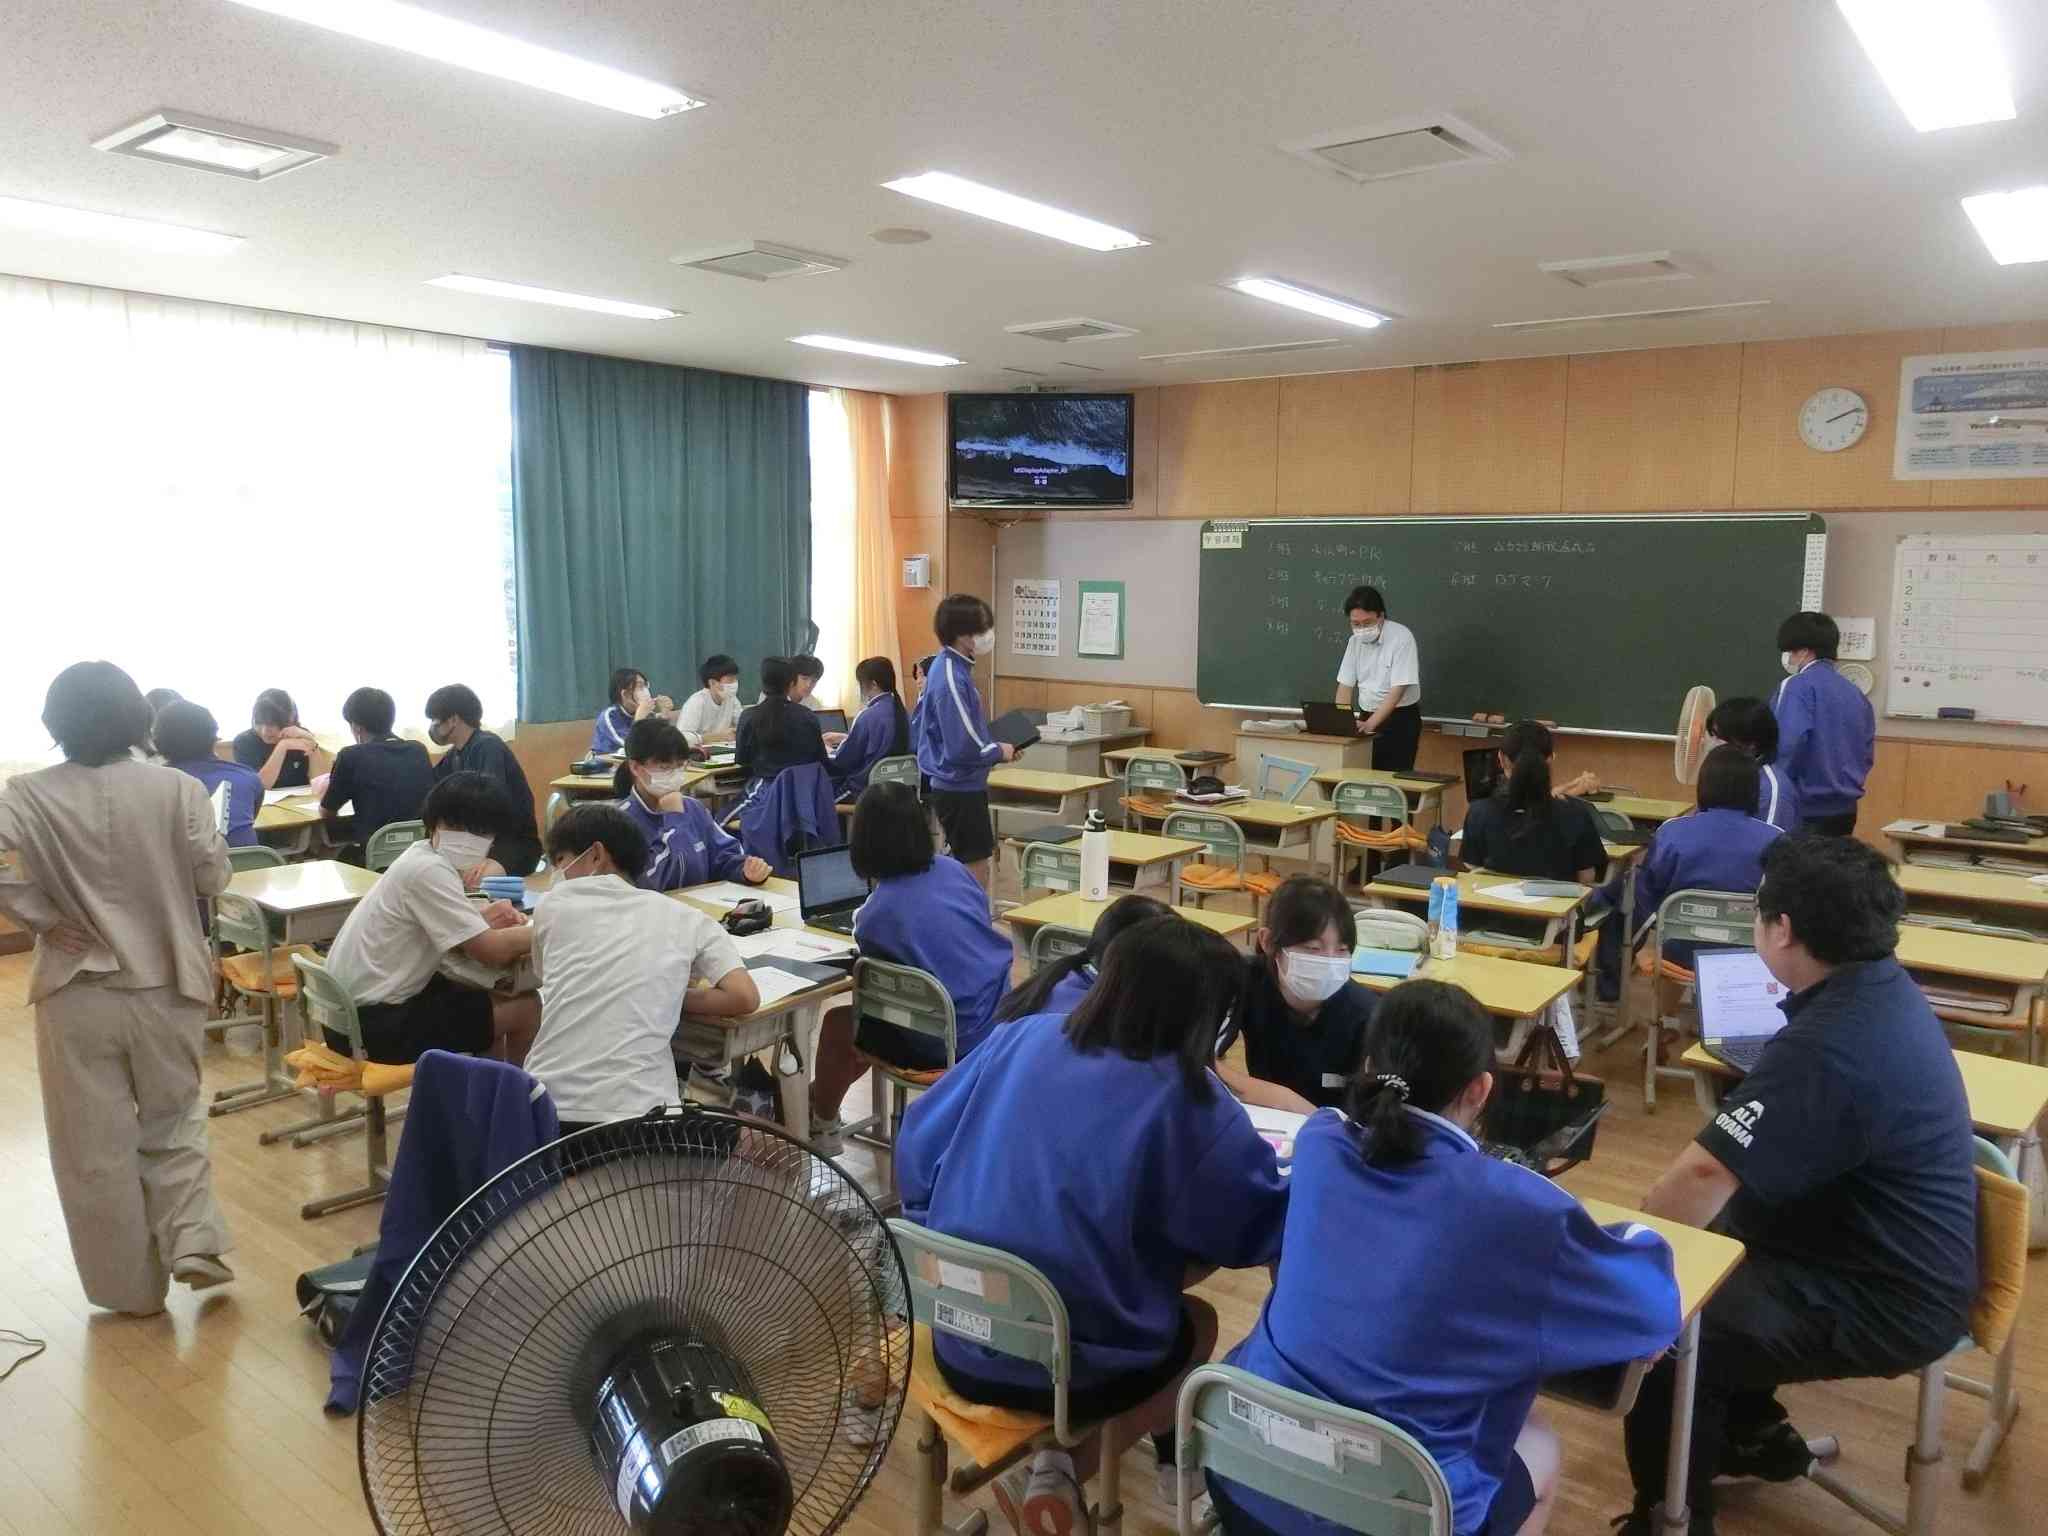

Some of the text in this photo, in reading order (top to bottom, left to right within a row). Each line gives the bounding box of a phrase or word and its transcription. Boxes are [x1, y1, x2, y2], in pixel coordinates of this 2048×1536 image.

[1904, 584, 1913, 596] 2
[1903, 600, 1912, 612] 3
[1731, 1106, 1756, 1130] ALL
[1715, 1112, 1754, 1148] OYAMA
